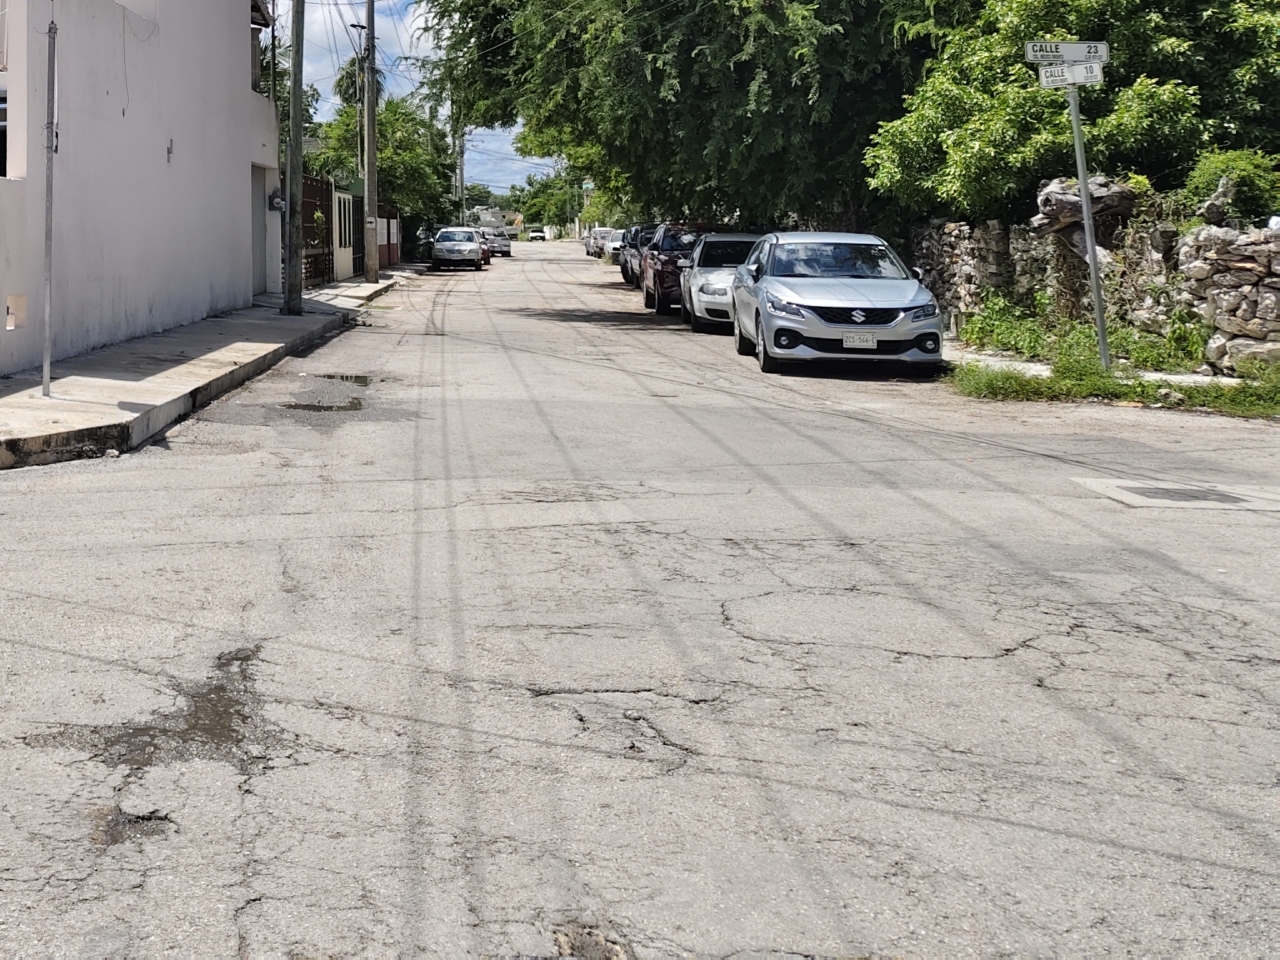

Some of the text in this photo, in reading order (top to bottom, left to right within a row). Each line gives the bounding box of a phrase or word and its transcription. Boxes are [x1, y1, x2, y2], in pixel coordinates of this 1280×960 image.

[1032, 44, 1099, 54] CALLE 23
[1044, 65, 1094, 78] CALLE 10
